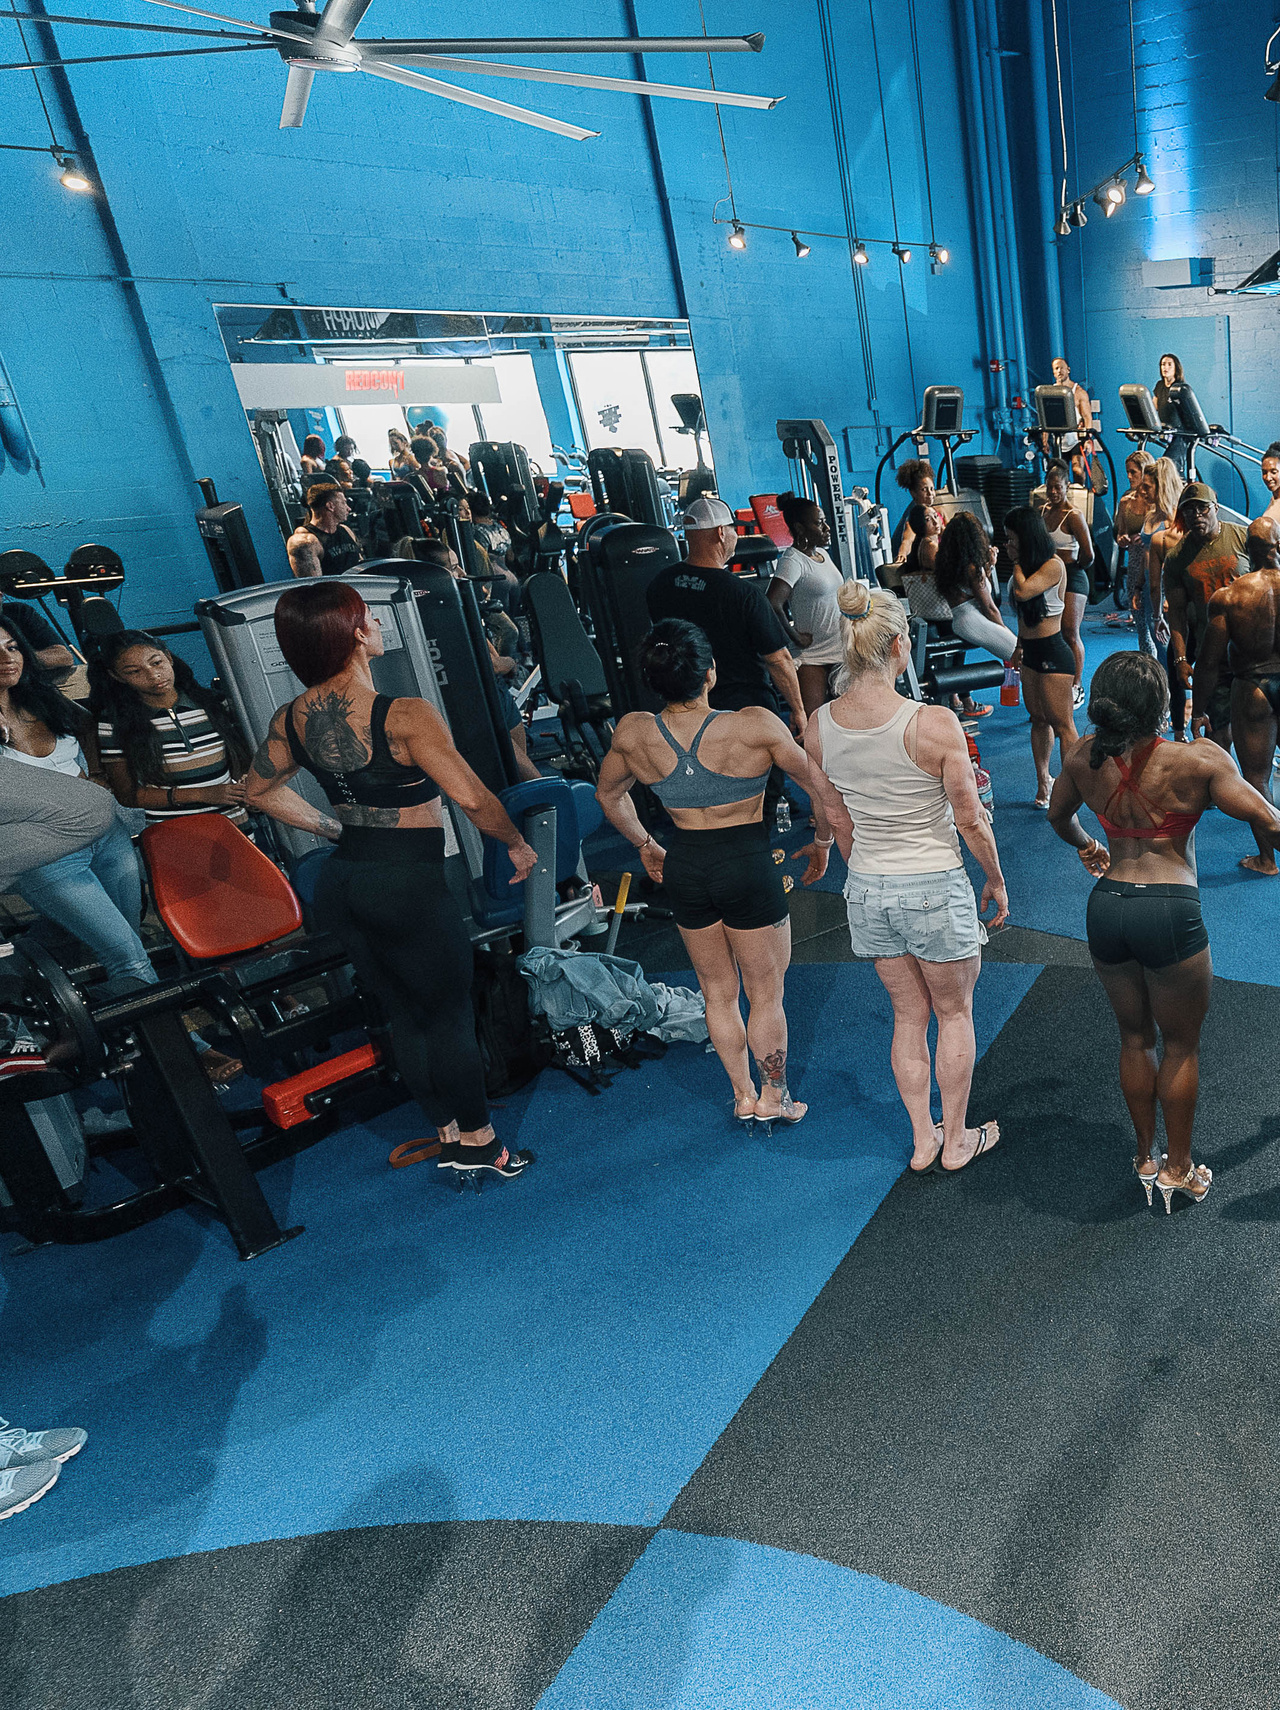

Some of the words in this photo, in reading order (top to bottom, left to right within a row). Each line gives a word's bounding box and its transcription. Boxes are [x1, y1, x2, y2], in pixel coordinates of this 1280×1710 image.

[345, 369, 405, 399] REDCON1
[828, 455, 842, 502] POWER
[835, 506, 847, 543] LIFT
